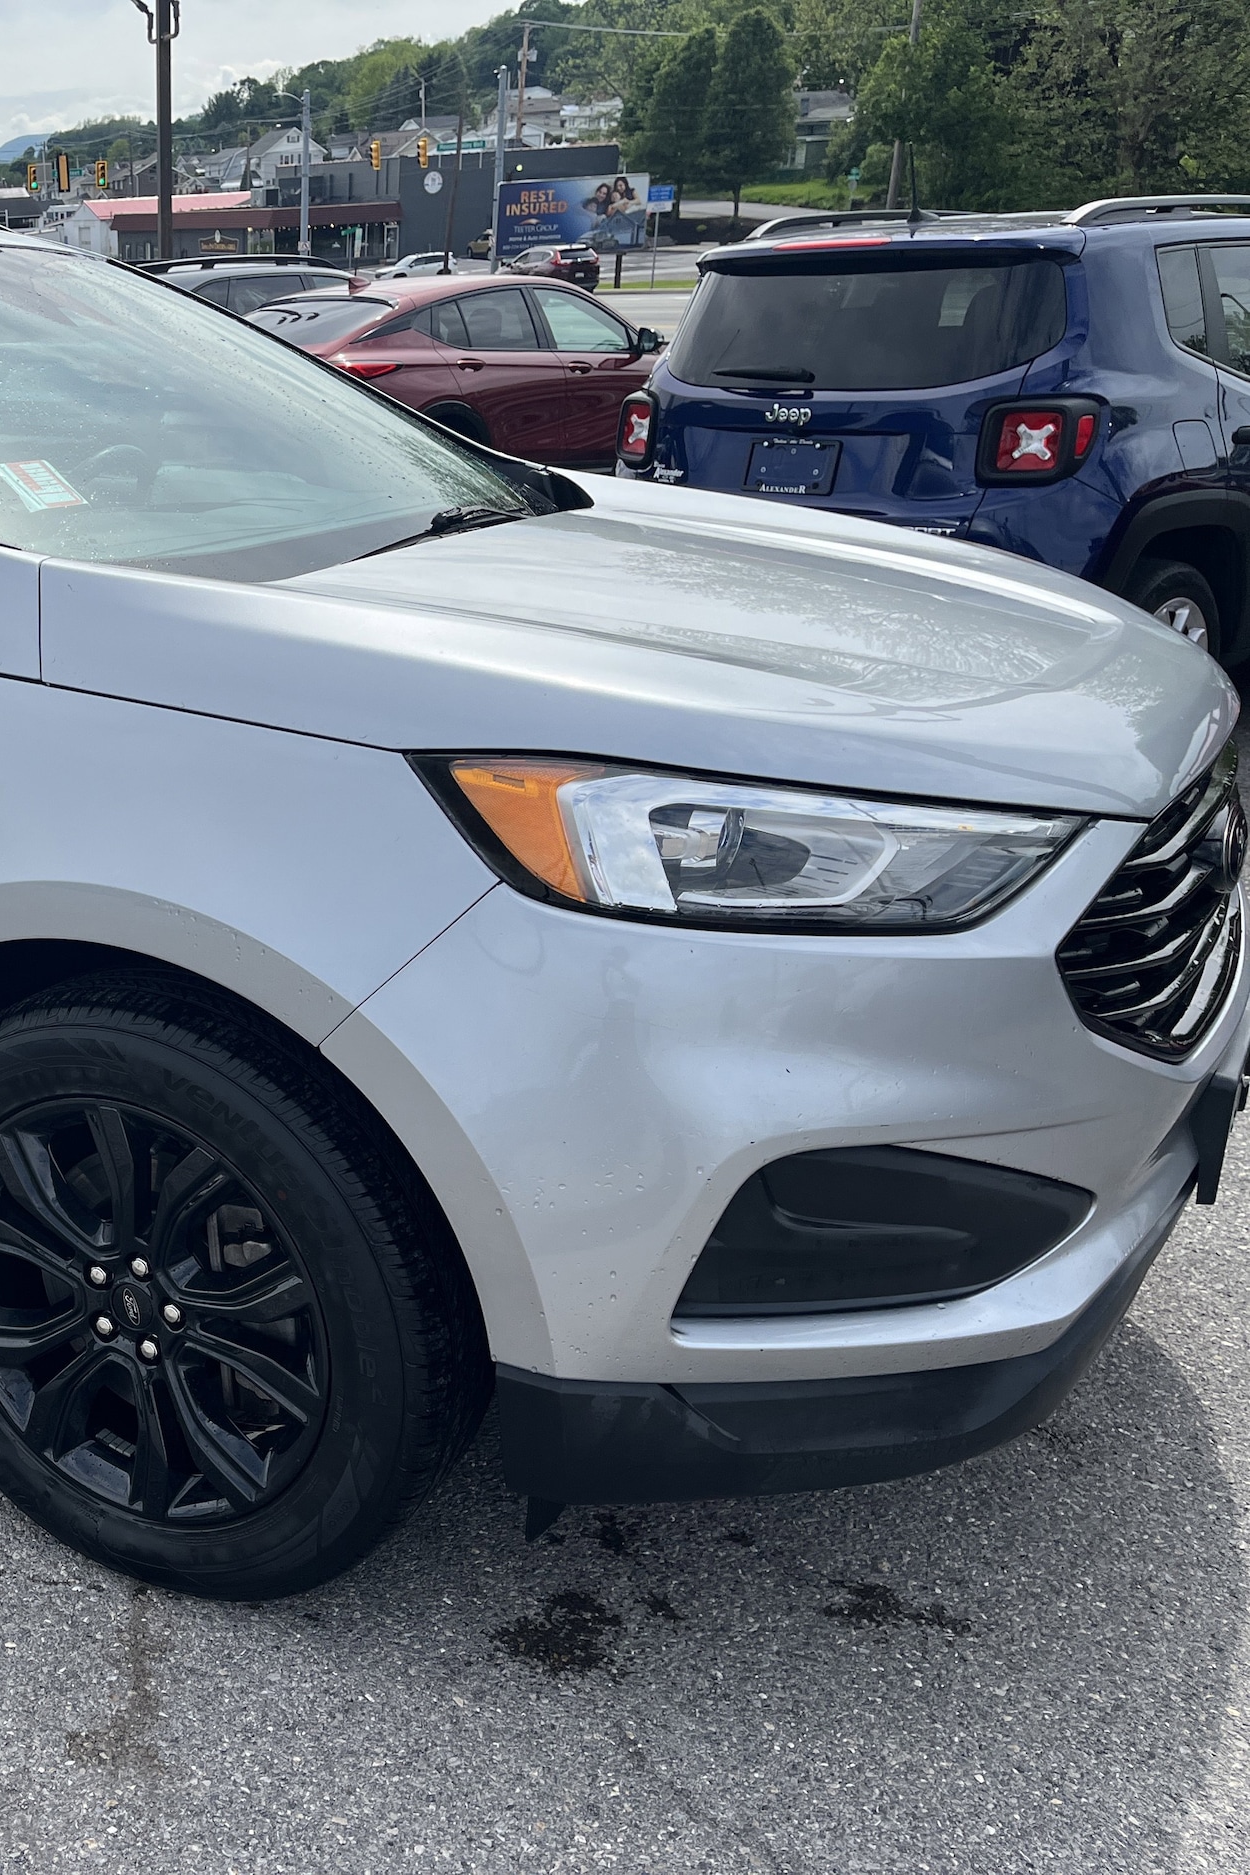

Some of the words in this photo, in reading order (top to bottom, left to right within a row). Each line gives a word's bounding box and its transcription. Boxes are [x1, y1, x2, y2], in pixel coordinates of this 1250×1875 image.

[520, 189, 556, 204] REST
[505, 200, 569, 217] INSURED
[765, 403, 812, 426] Jeep
